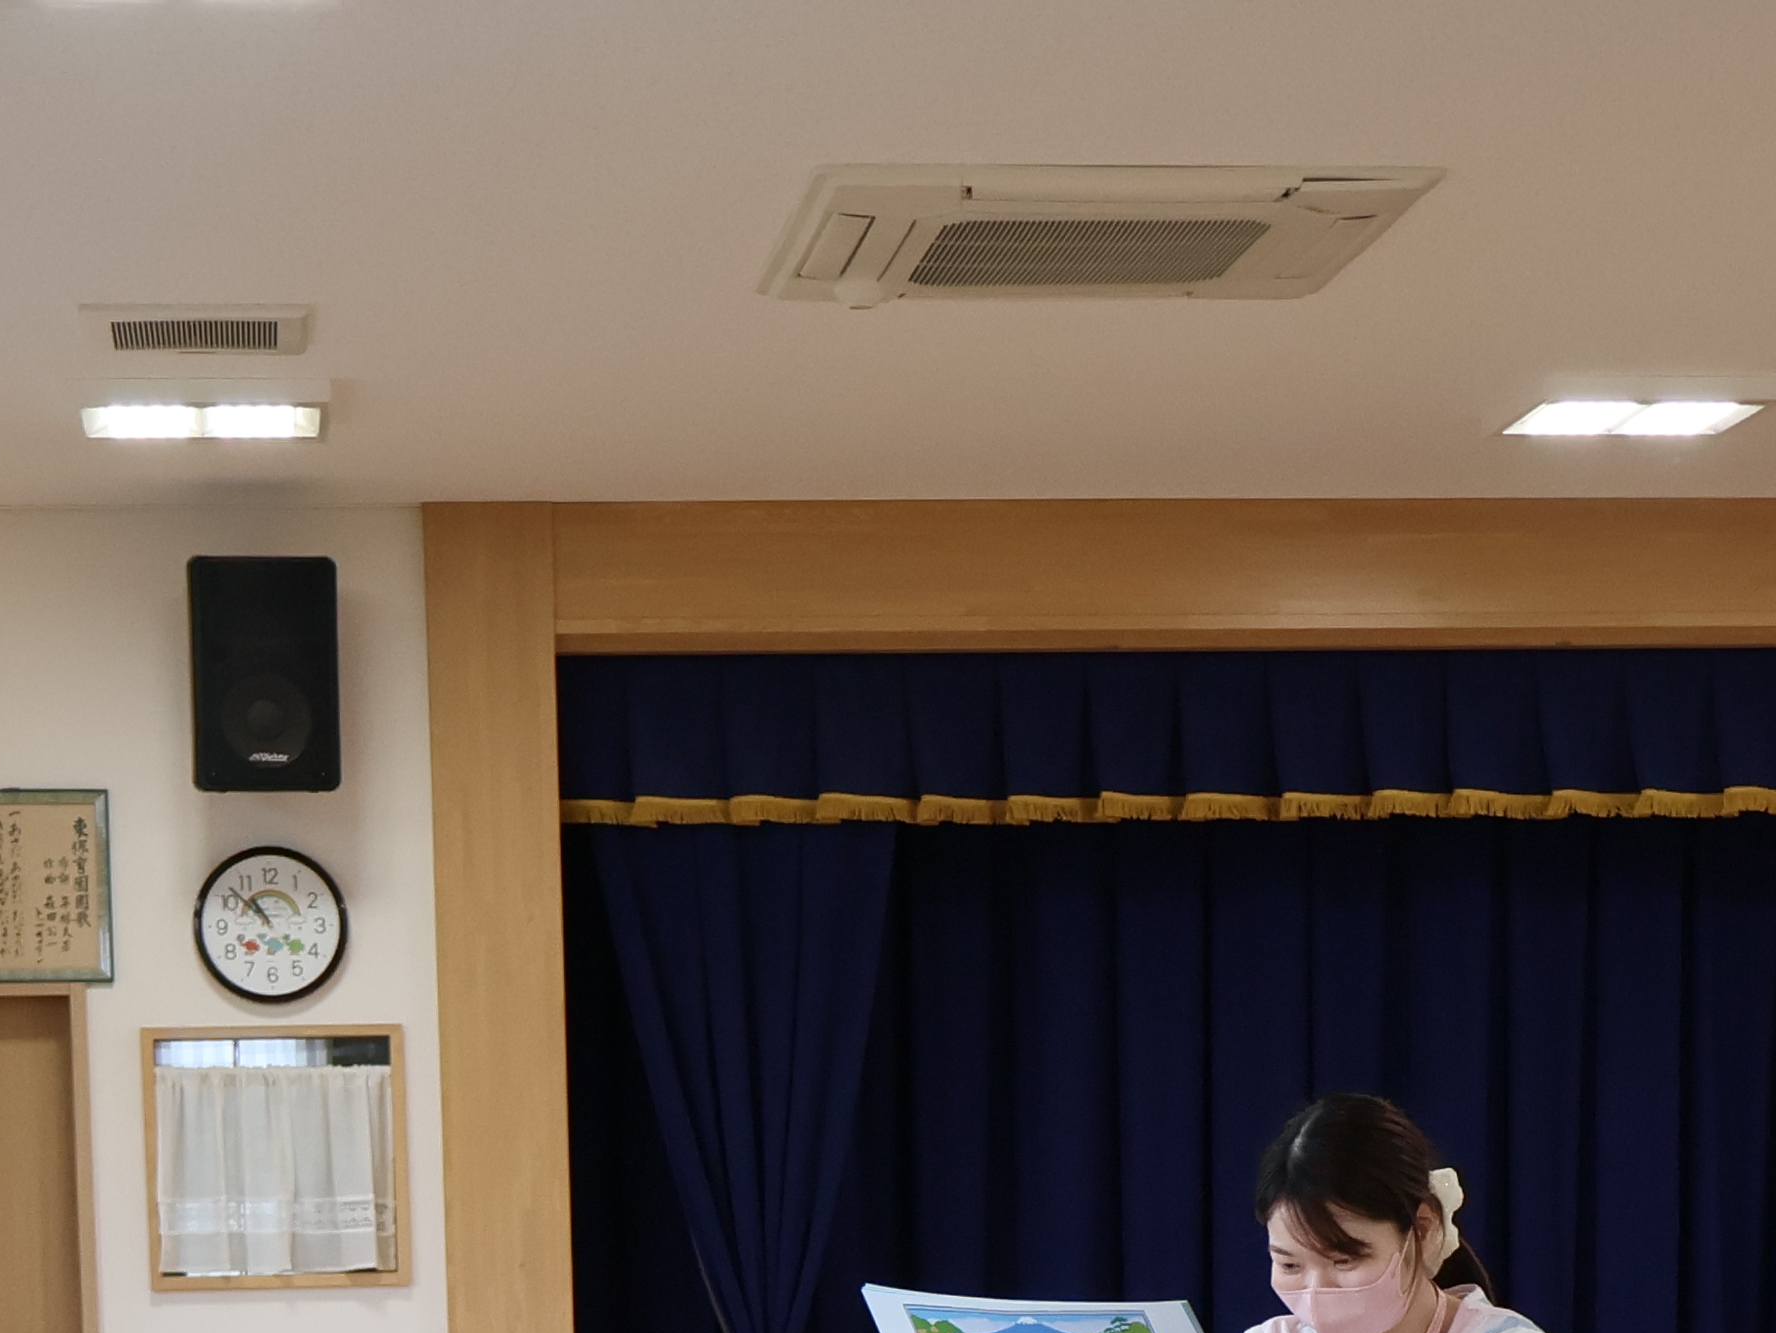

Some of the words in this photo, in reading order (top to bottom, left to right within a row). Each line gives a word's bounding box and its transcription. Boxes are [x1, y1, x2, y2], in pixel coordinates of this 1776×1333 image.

[239, 874, 253, 892] 11
[261, 867, 279, 885] 12
[292, 874, 298, 891] 1
[221, 893, 239, 912] 10
[307, 891, 319, 909] 2
[216, 918, 229, 936] 9
[314, 917, 327, 934] 3
[224, 943, 237, 960] 8
[307, 942, 320, 959] 4
[244, 960, 255, 977] 7
[266, 966, 279, 983] 6
[292, 960, 304, 977] 5
